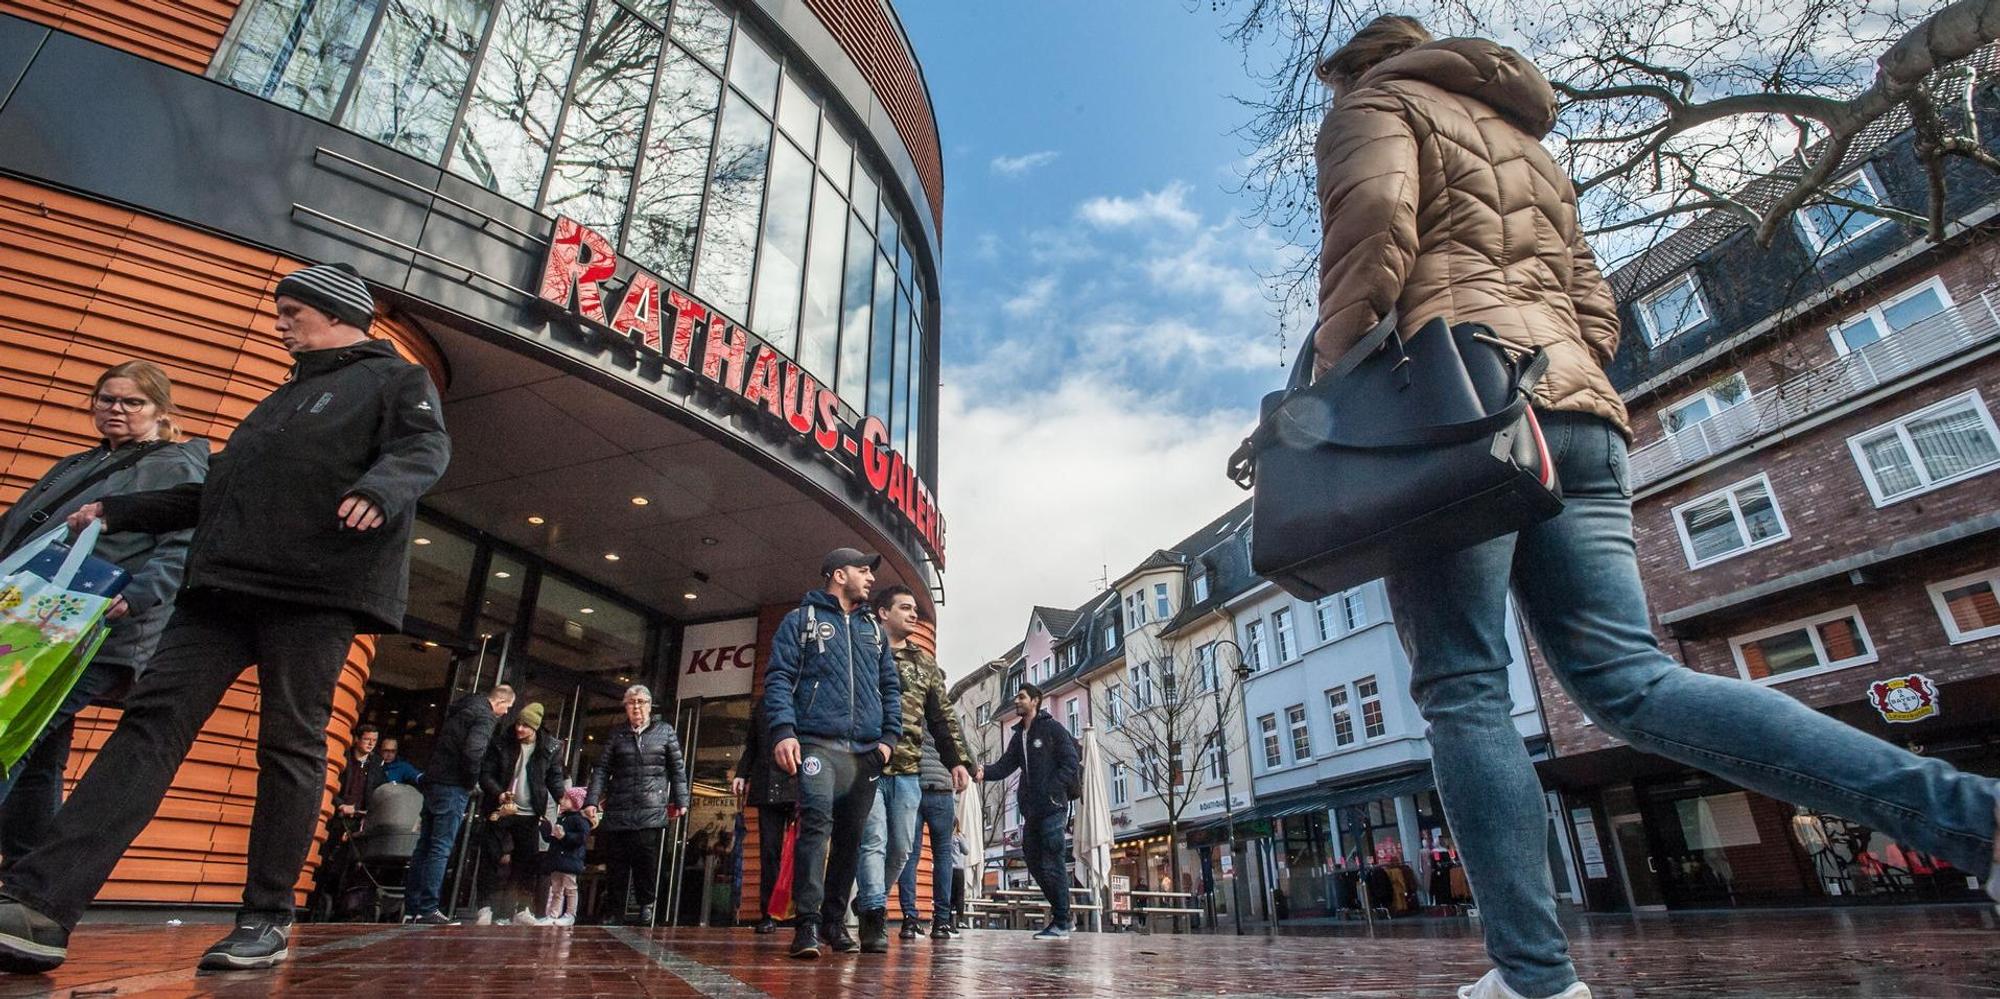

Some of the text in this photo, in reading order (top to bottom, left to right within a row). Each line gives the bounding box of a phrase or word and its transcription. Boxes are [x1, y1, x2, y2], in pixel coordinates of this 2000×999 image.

[538, 214, 946, 569] RATHAUS-GALERIE
[685, 643, 757, 675] KFC
[1891, 695, 1917, 704] BAYER
